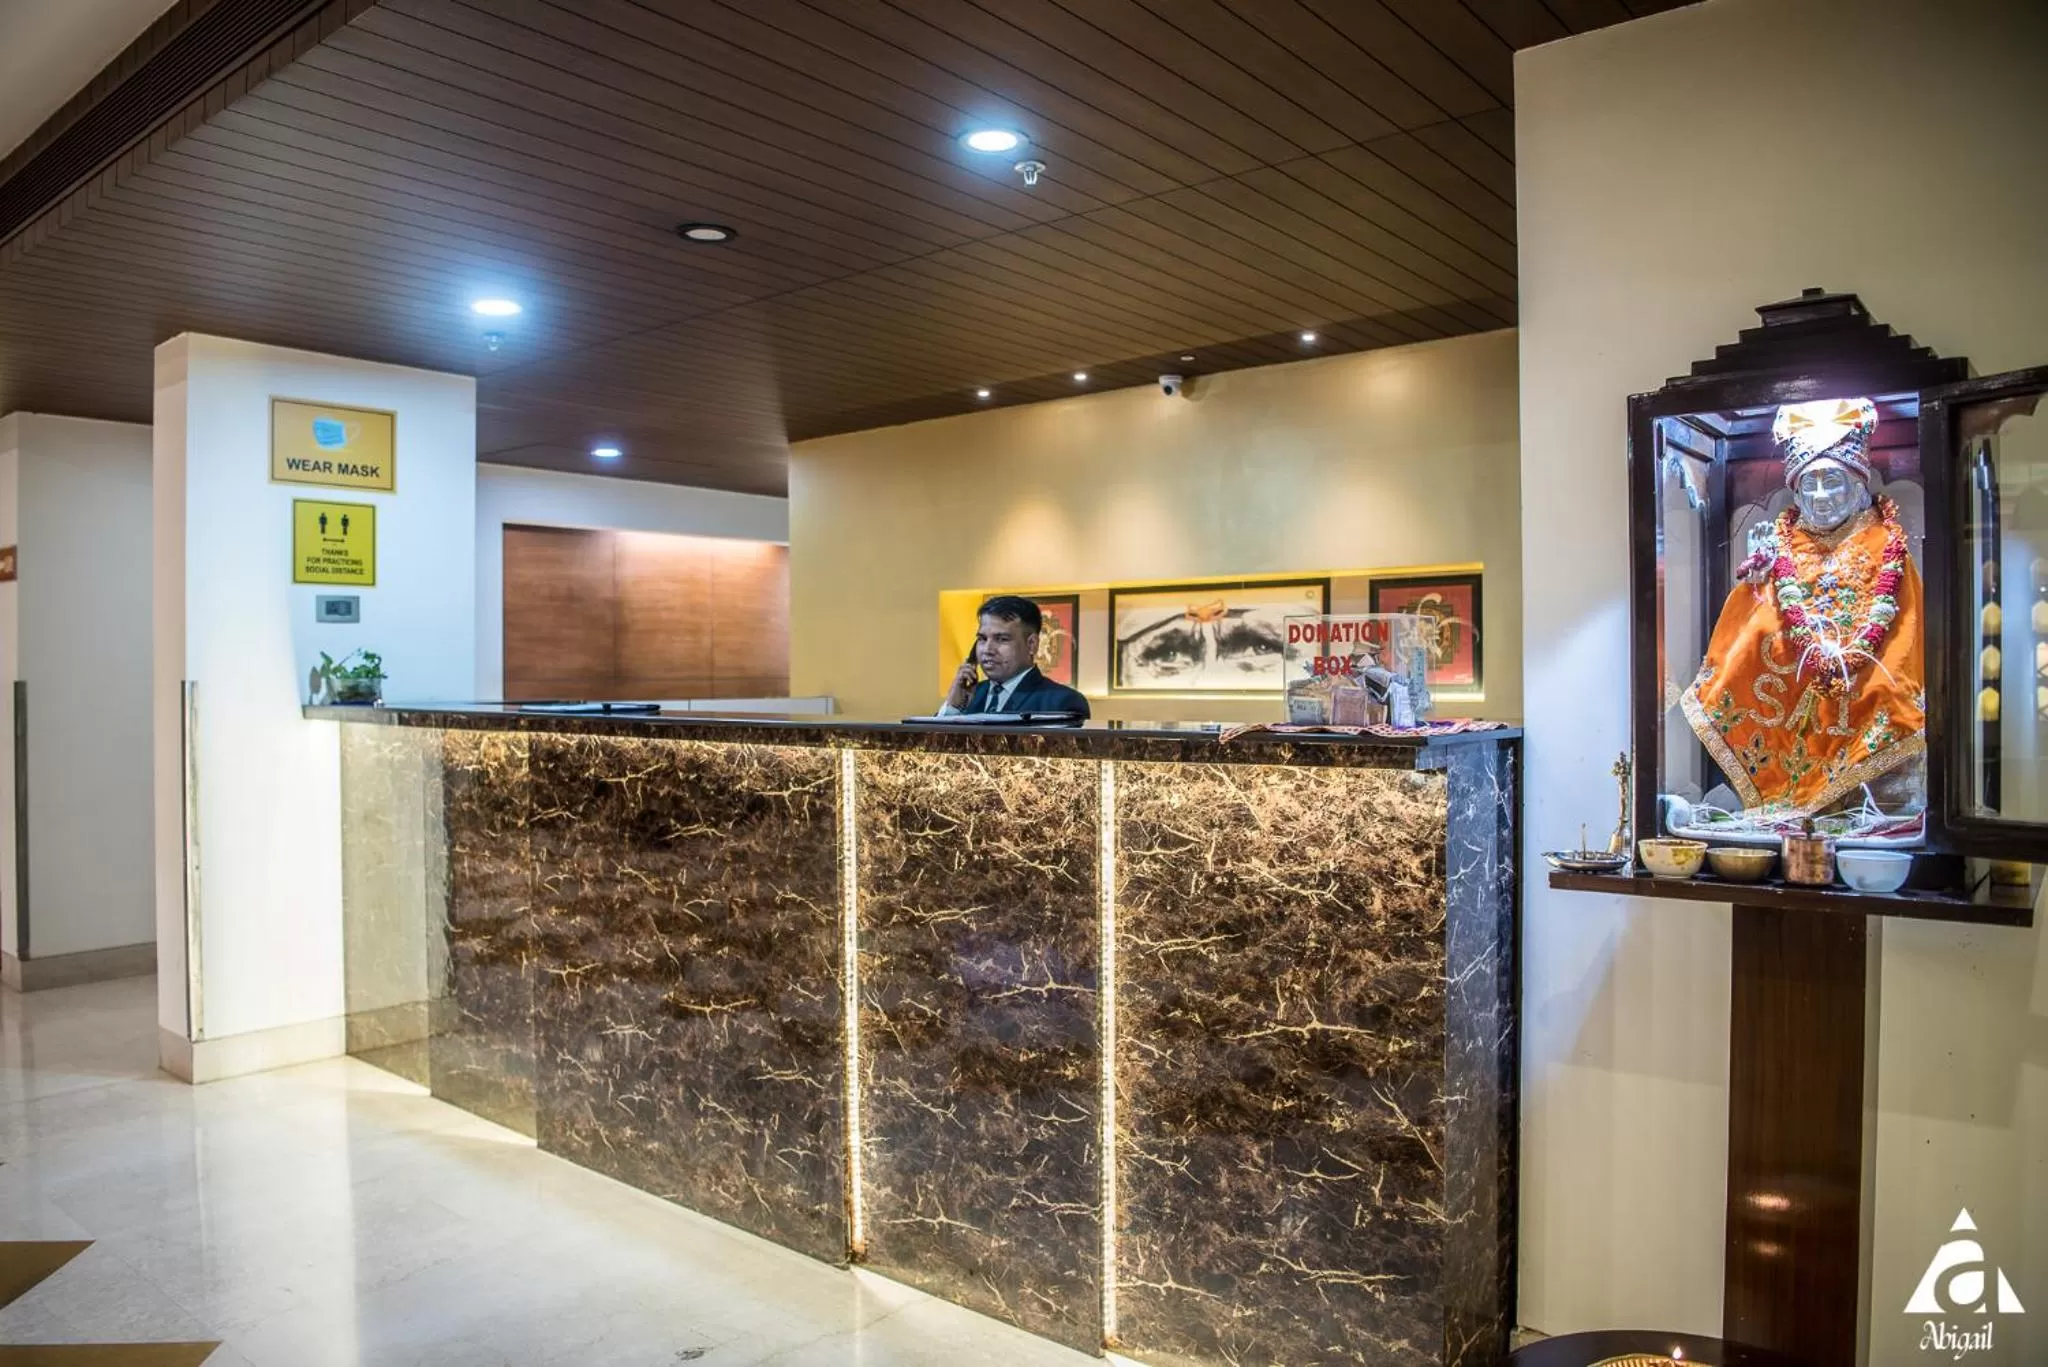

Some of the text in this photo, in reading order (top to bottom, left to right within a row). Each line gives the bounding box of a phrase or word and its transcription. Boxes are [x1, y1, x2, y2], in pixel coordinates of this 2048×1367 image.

[287, 457, 381, 478] WEAR MASK
[1288, 621, 1390, 644] DONATION
[1312, 655, 1354, 677] BOX
